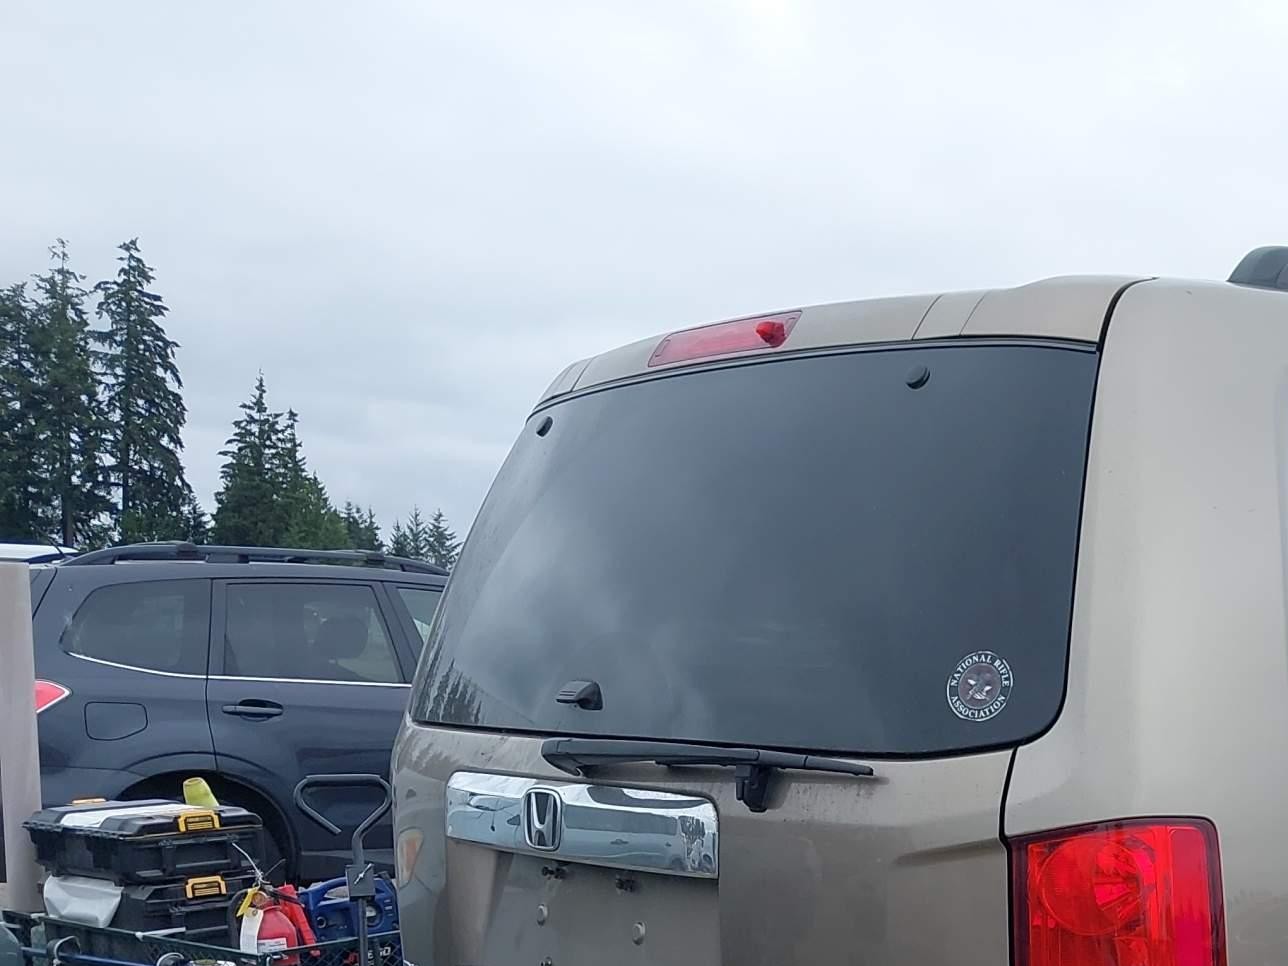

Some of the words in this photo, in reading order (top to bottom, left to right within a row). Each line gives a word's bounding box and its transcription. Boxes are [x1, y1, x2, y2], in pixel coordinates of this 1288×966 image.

[950, 654, 992, 687] NATIONAL
[993, 659, 1010, 687] RIFLE
[950, 695, 1006, 718] ASSOCIATION
